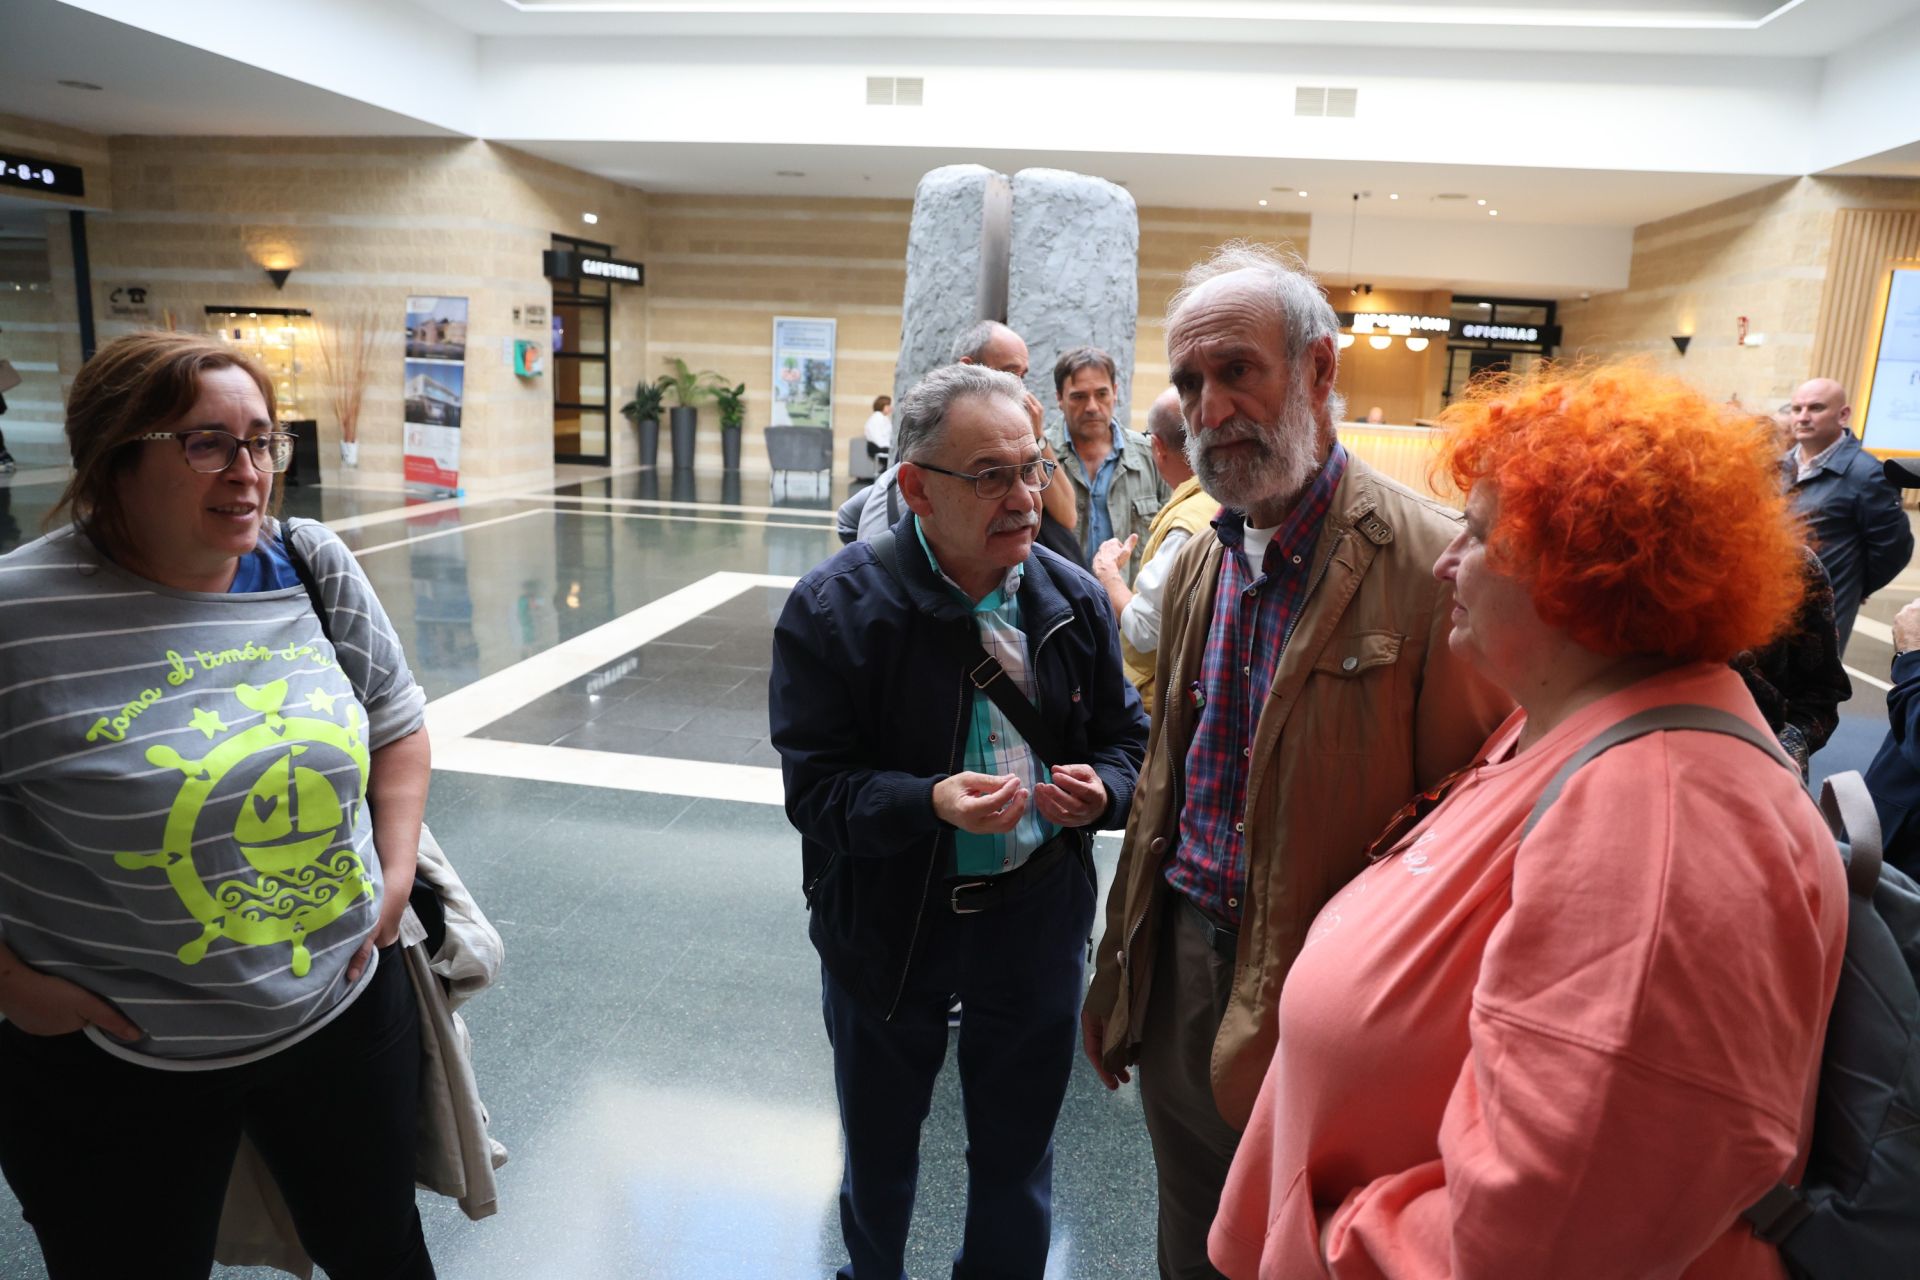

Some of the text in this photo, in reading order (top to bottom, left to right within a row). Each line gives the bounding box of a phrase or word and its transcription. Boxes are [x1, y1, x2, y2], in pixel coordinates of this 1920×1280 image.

[1463, 324, 1537, 341] OFICINAS
[86, 687, 162, 742] Toma
[194, 641, 273, 670] timón
